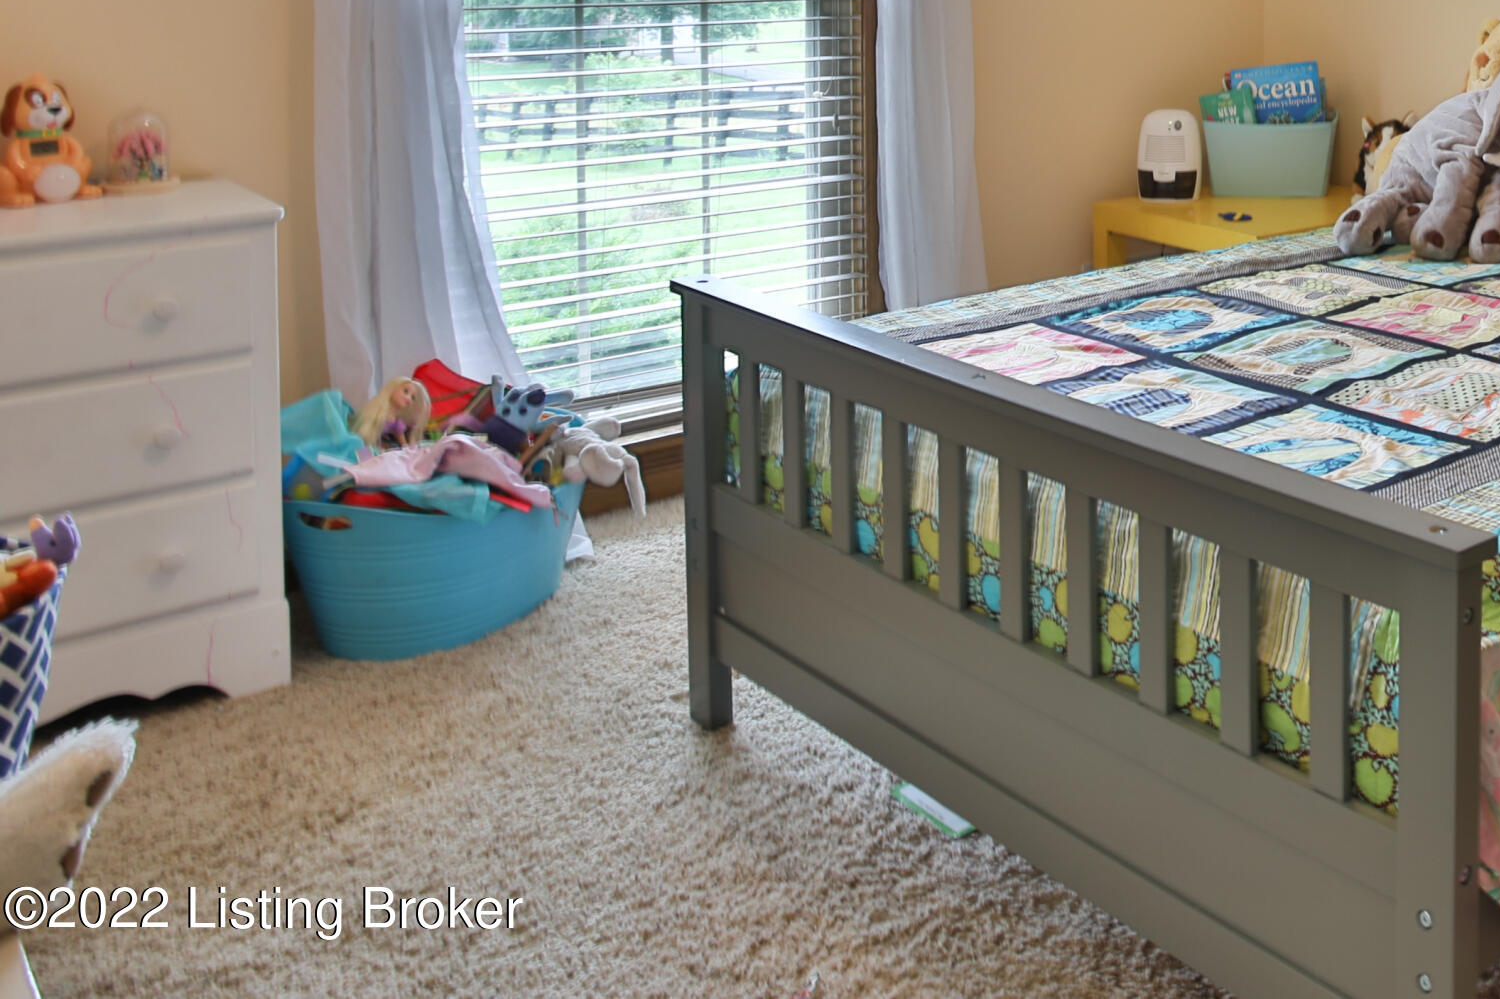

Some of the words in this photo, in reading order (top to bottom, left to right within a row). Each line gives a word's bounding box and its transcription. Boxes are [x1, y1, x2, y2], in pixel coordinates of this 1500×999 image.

[1237, 78, 1315, 100] Ocean
[1267, 96, 1318, 110] encyclopedia
[1218, 105, 1238, 118] NEW
